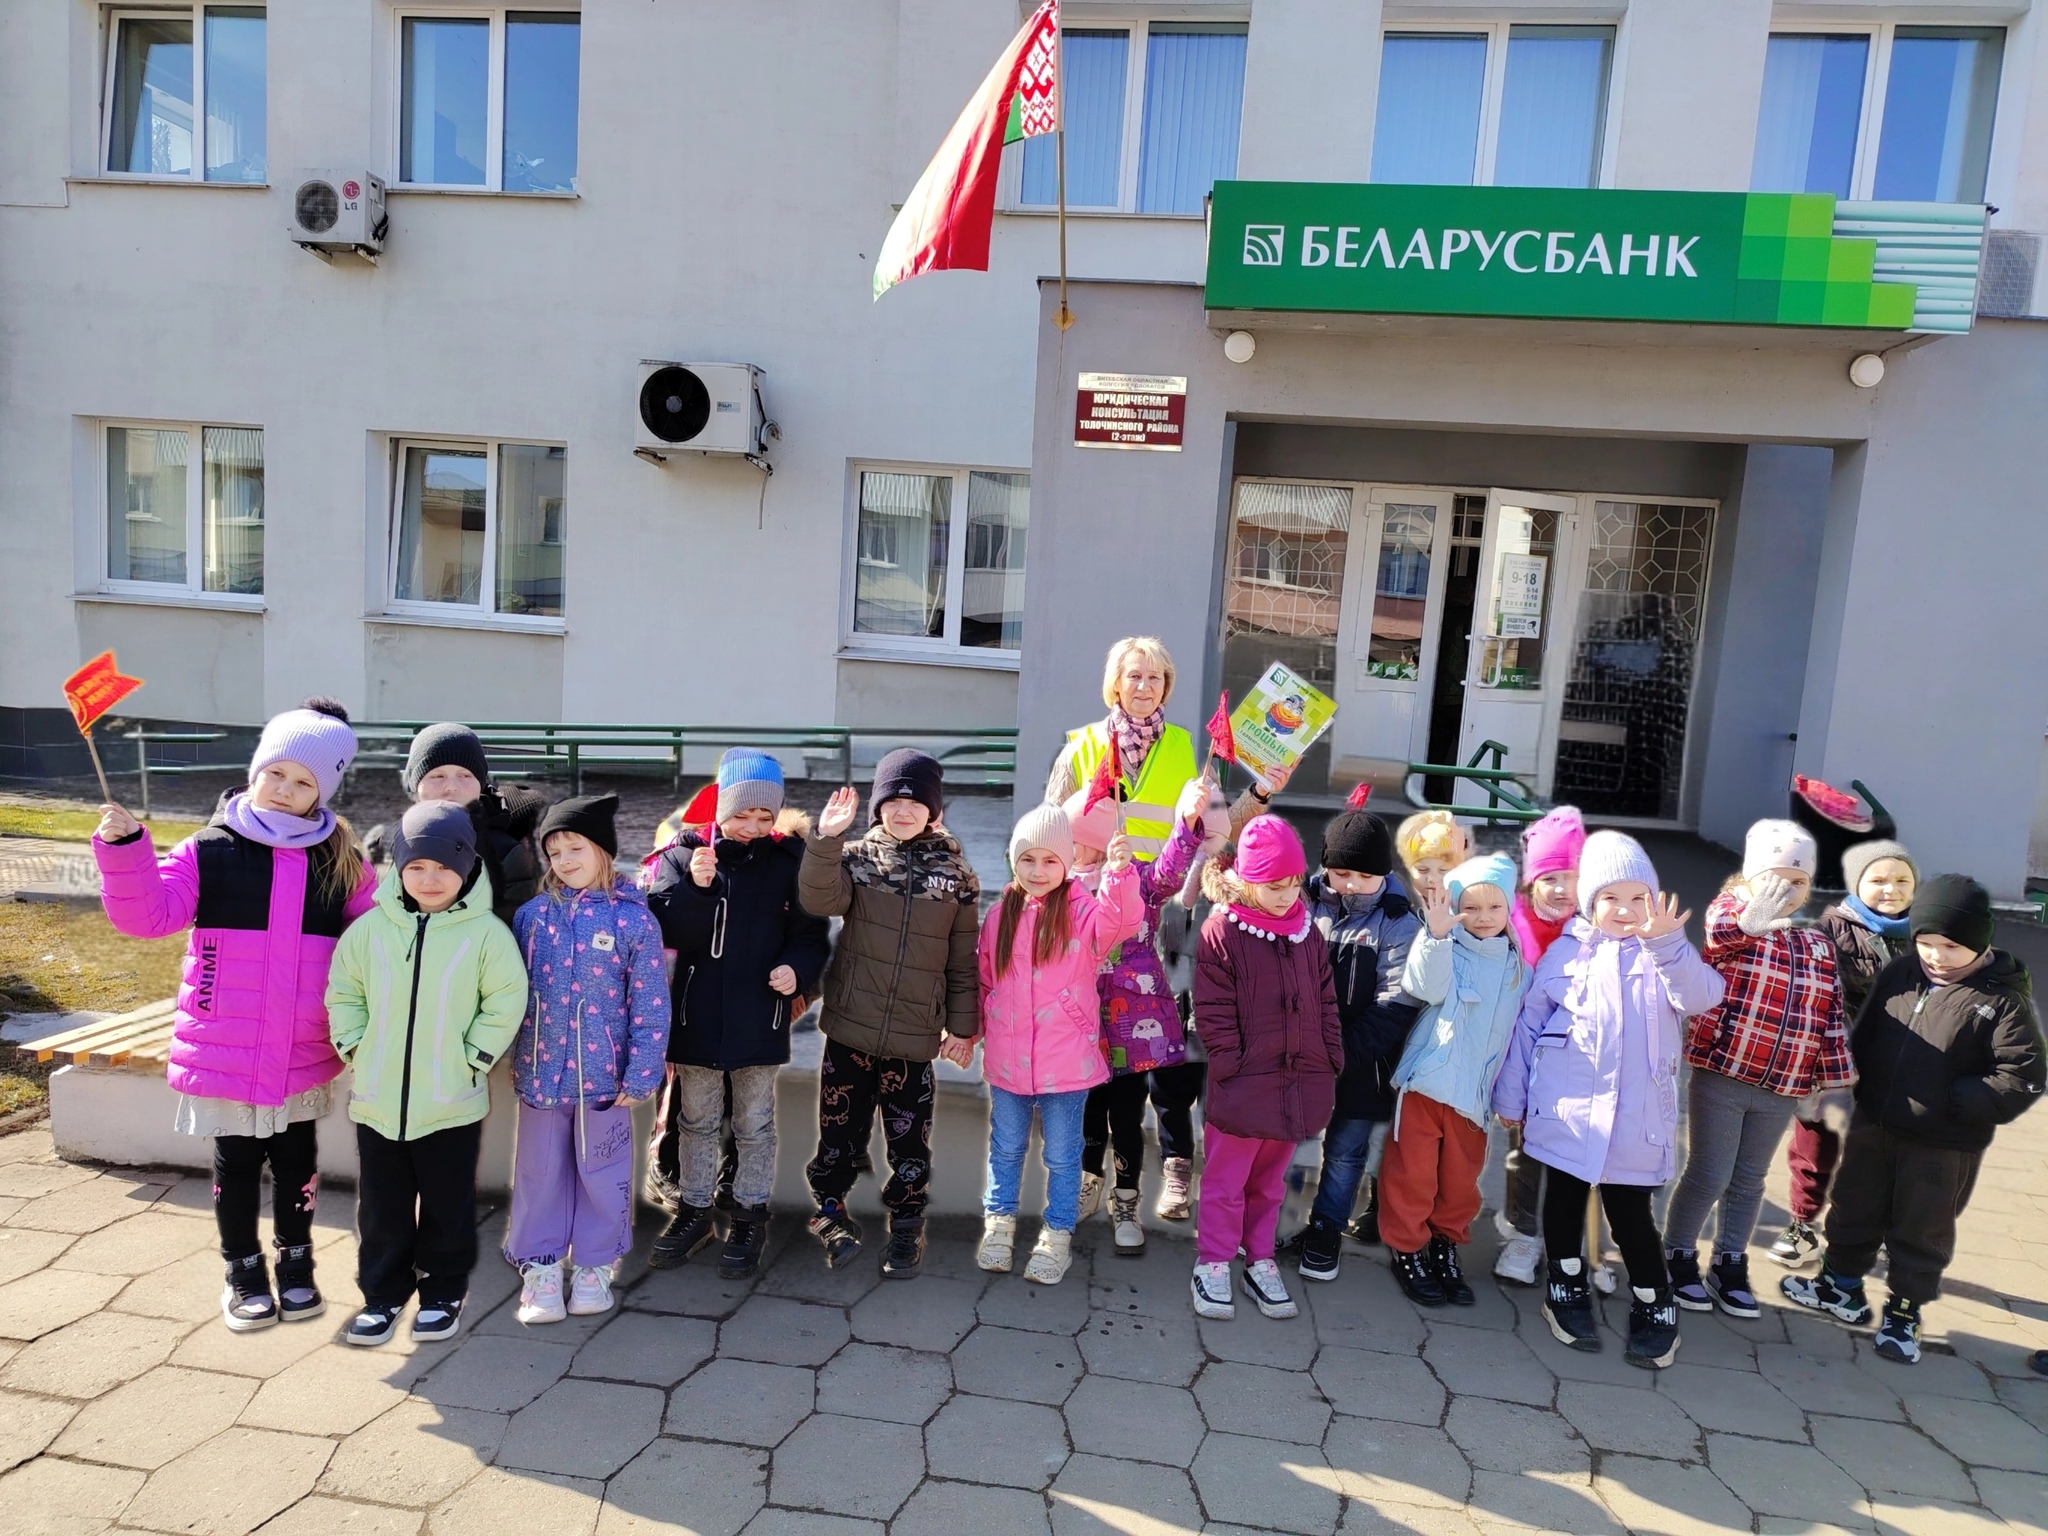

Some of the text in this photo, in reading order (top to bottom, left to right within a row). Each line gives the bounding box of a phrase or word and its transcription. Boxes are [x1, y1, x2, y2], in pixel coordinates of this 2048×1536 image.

[344, 202, 358, 210] LG
[1300, 225, 1701, 278] БЕЛАРУСБАНК
[1093, 392, 1169, 407] ЮРИДИЧЕСКАЯ
[1091, 407, 1169, 421] КОНСУЛЬТАЦИЯ
[1080, 420, 1179, 434] ТОЛОЧИНСКОГО РАЙОНА
[1111, 433, 1146, 442] (2-этаж)
[1511, 571, 1537, 585] 9-18
[927, 875, 955, 893] NYC
[197, 936, 219, 1012] ANIME
